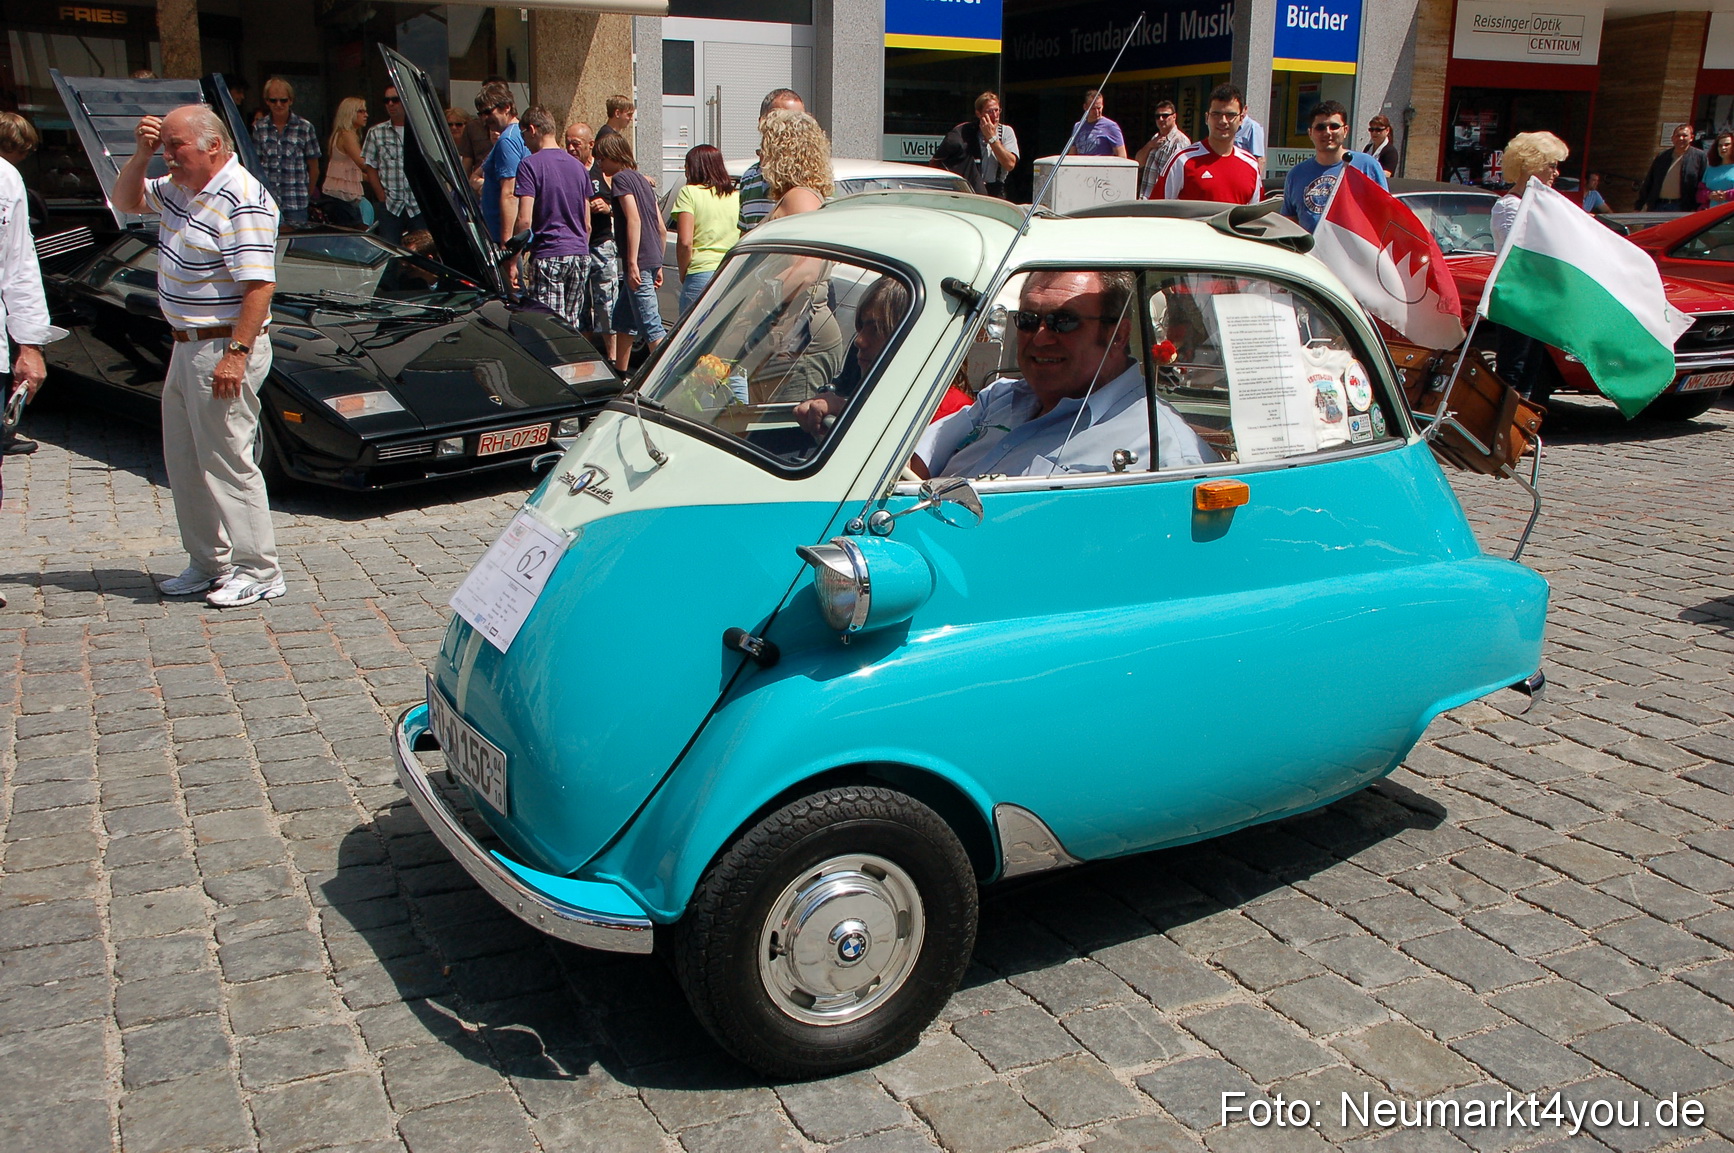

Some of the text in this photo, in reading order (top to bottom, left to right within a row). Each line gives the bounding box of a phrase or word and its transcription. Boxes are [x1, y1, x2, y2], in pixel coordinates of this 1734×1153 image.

[60, 6, 128, 24] FRIES
[1286, 4, 1348, 31] Bücher
[1473, 14, 1561, 33] Reissinger Optik
[1013, 3, 1233, 61] Videos Trendartikel Musik
[1530, 38, 1580, 51] CENTRUM
[1182, 87, 1195, 134] ltbild
[480, 427, 549, 454] RH-0738
[516, 545, 547, 580] 62
